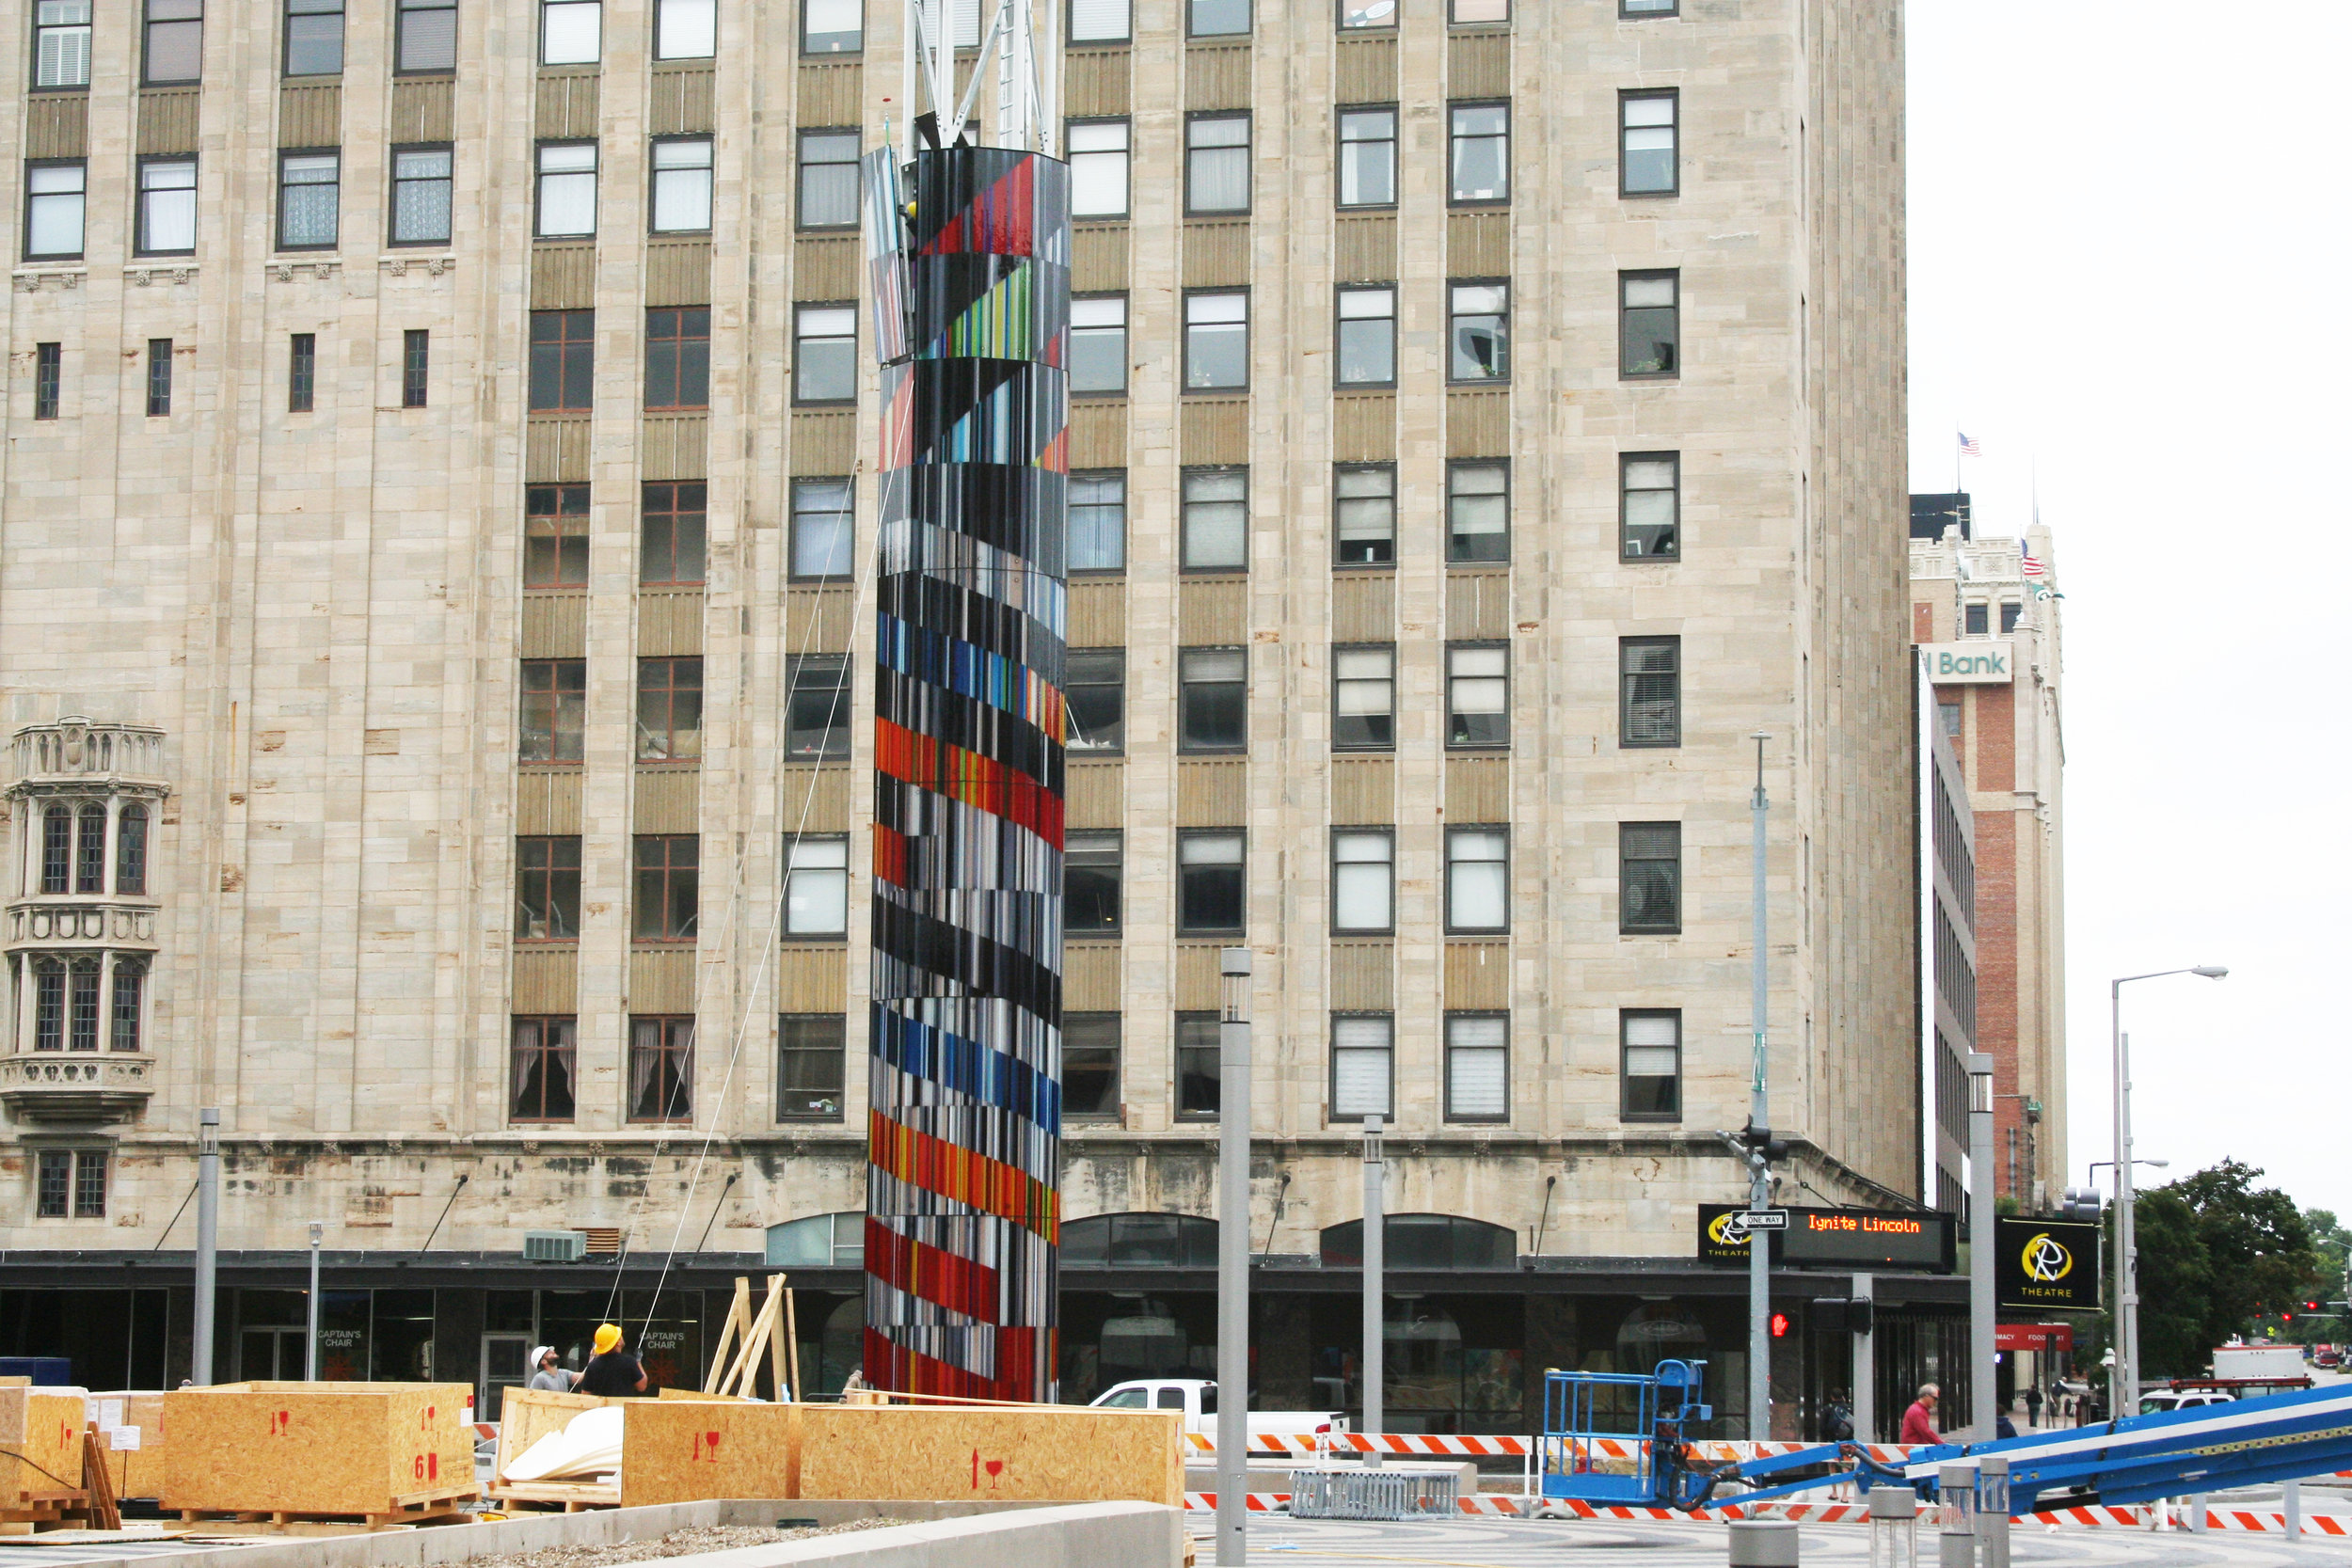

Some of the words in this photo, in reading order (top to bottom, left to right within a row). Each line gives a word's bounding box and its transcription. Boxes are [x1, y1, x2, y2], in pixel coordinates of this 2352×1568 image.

[1939, 651, 2006, 674] Bank
[1808, 1214, 1857, 1231] Ignite
[1863, 1216, 1921, 1233] Lincoln
[2021, 1287, 2073, 1298] THEATRE
[317, 1330, 361, 1338] CAPTAIN'S
[640, 1332, 685, 1340] CAPTAIN'S
[325, 1338, 353, 1347] CHAIR
[647, 1340, 675, 1349] CHAIR
